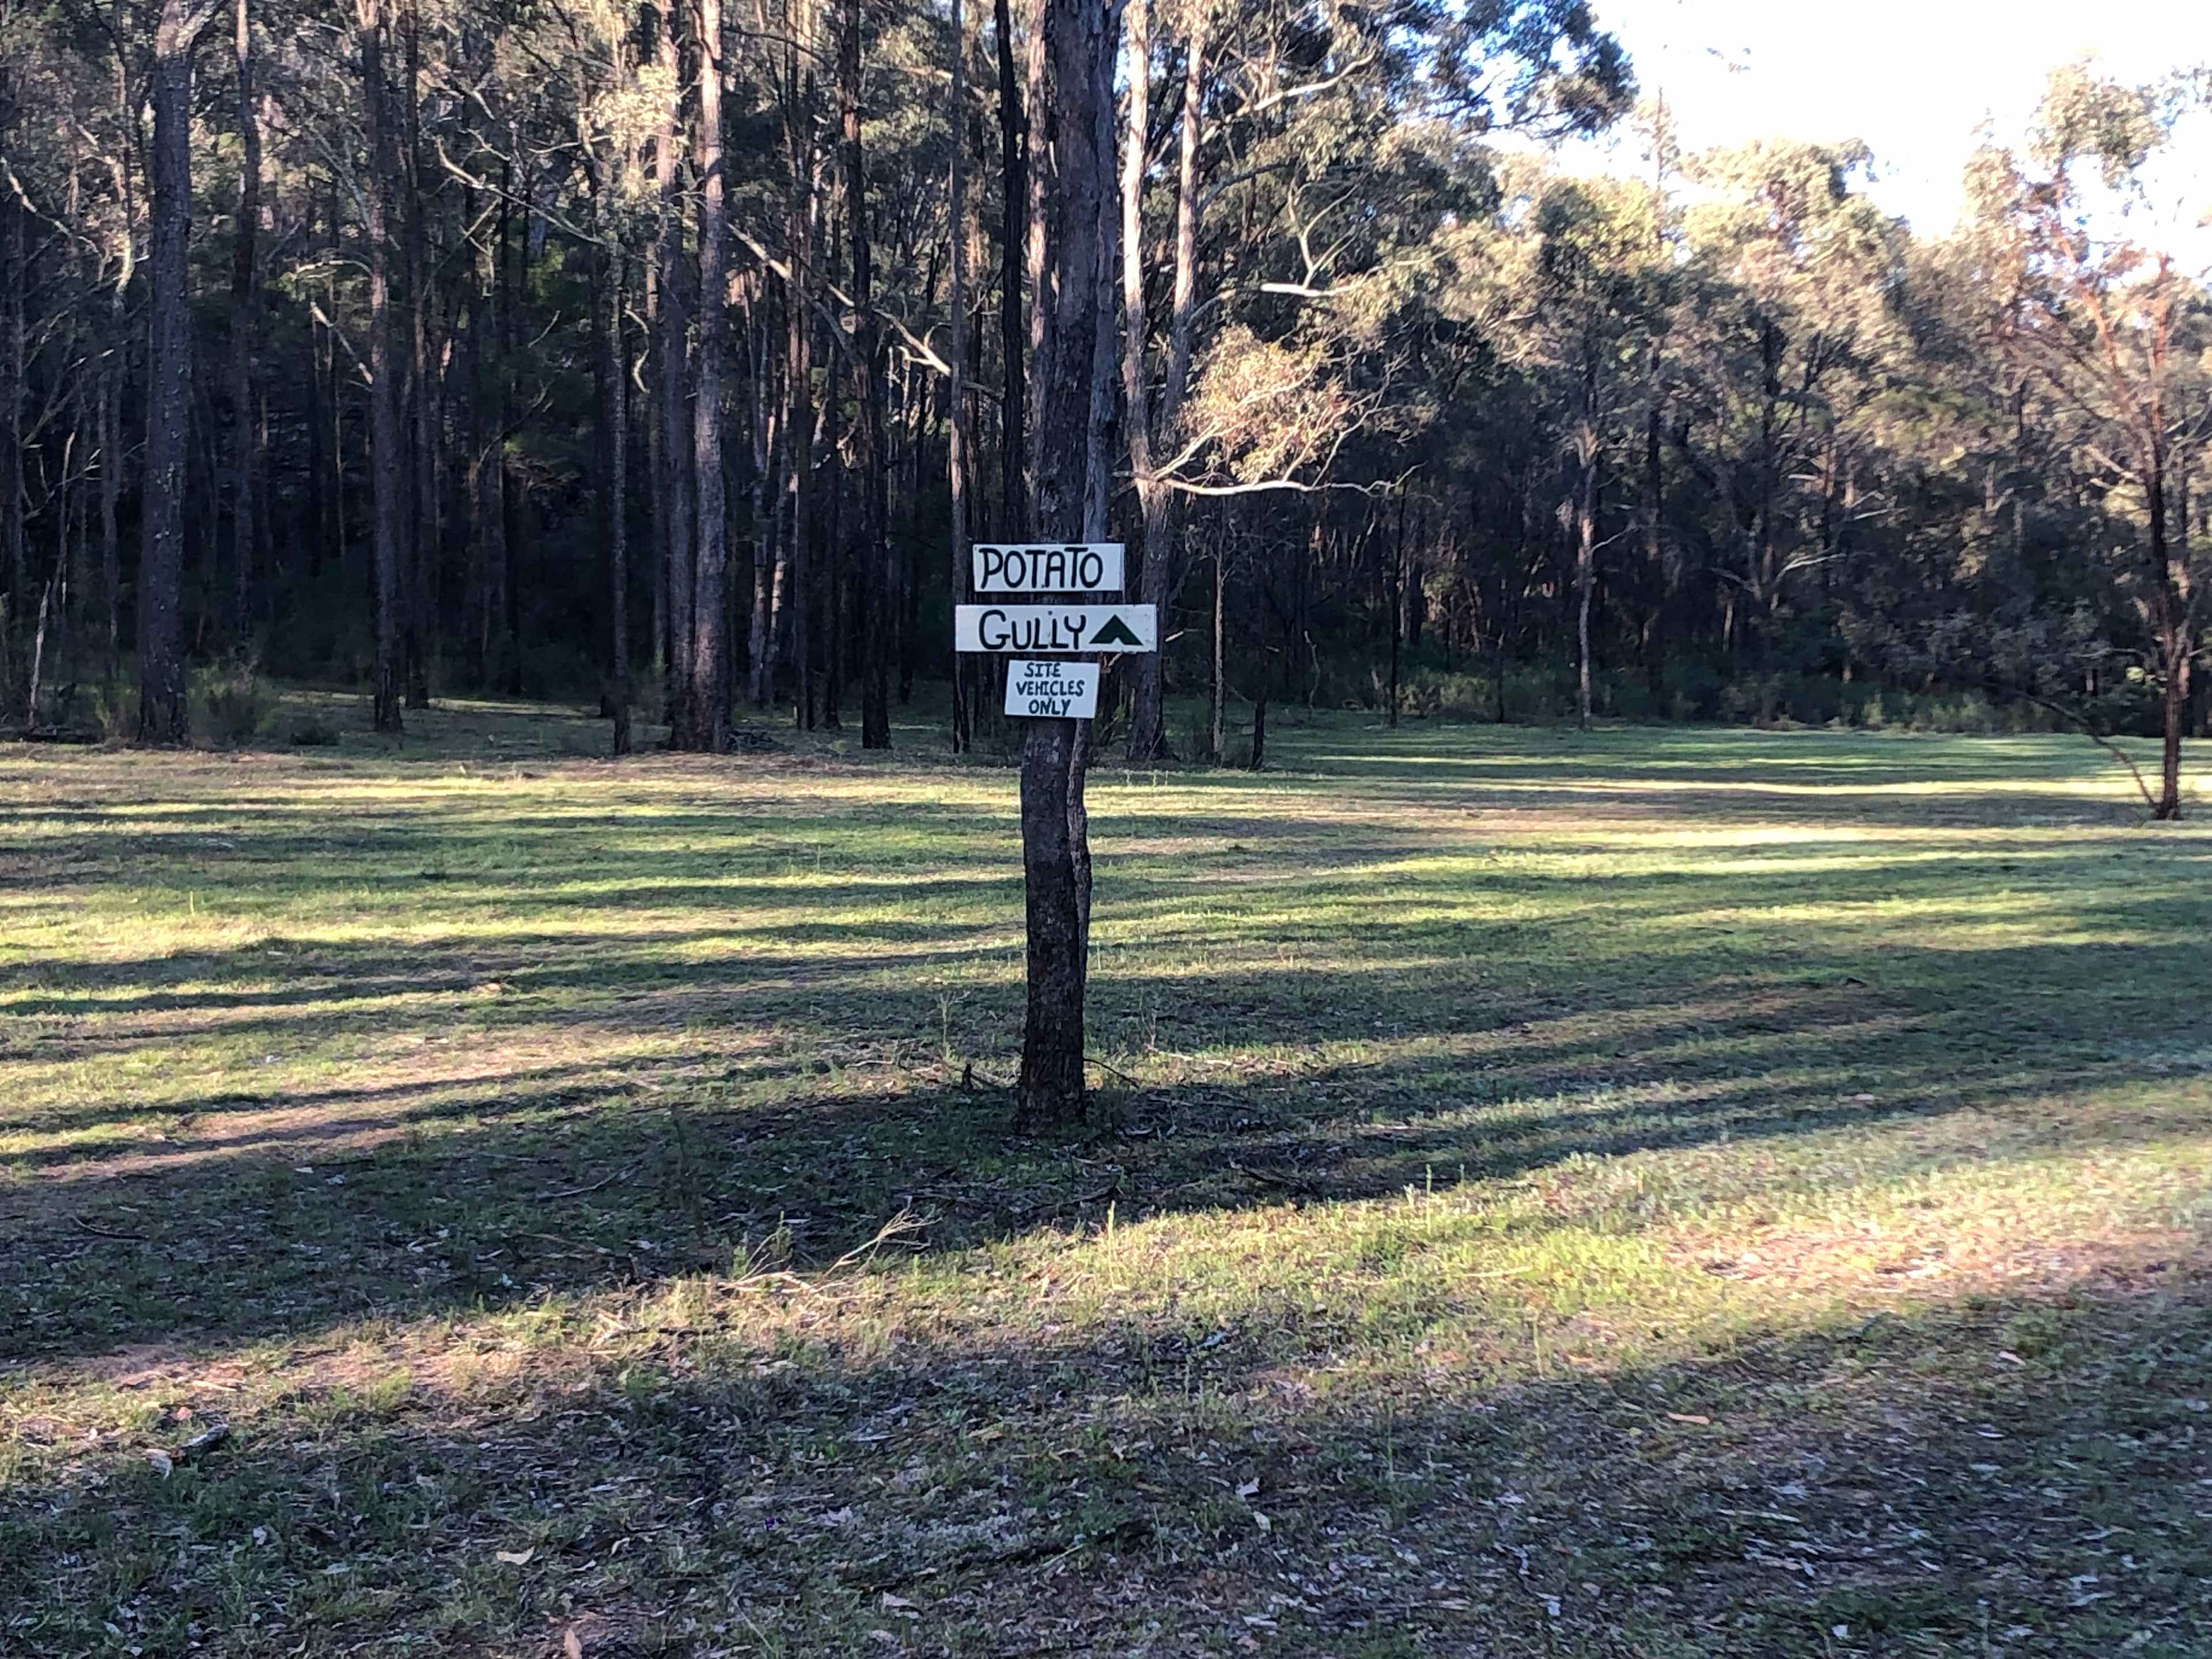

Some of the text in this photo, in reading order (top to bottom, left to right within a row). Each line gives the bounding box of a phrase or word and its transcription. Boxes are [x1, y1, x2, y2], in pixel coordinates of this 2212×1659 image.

[979, 547, 1103, 589] POTATO
[979, 609, 1086, 650] GULLY
[1024, 662, 1062, 677] SITE
[1016, 680, 1085, 697] VEHICLES
[1028, 698, 1071, 715] ONLY
